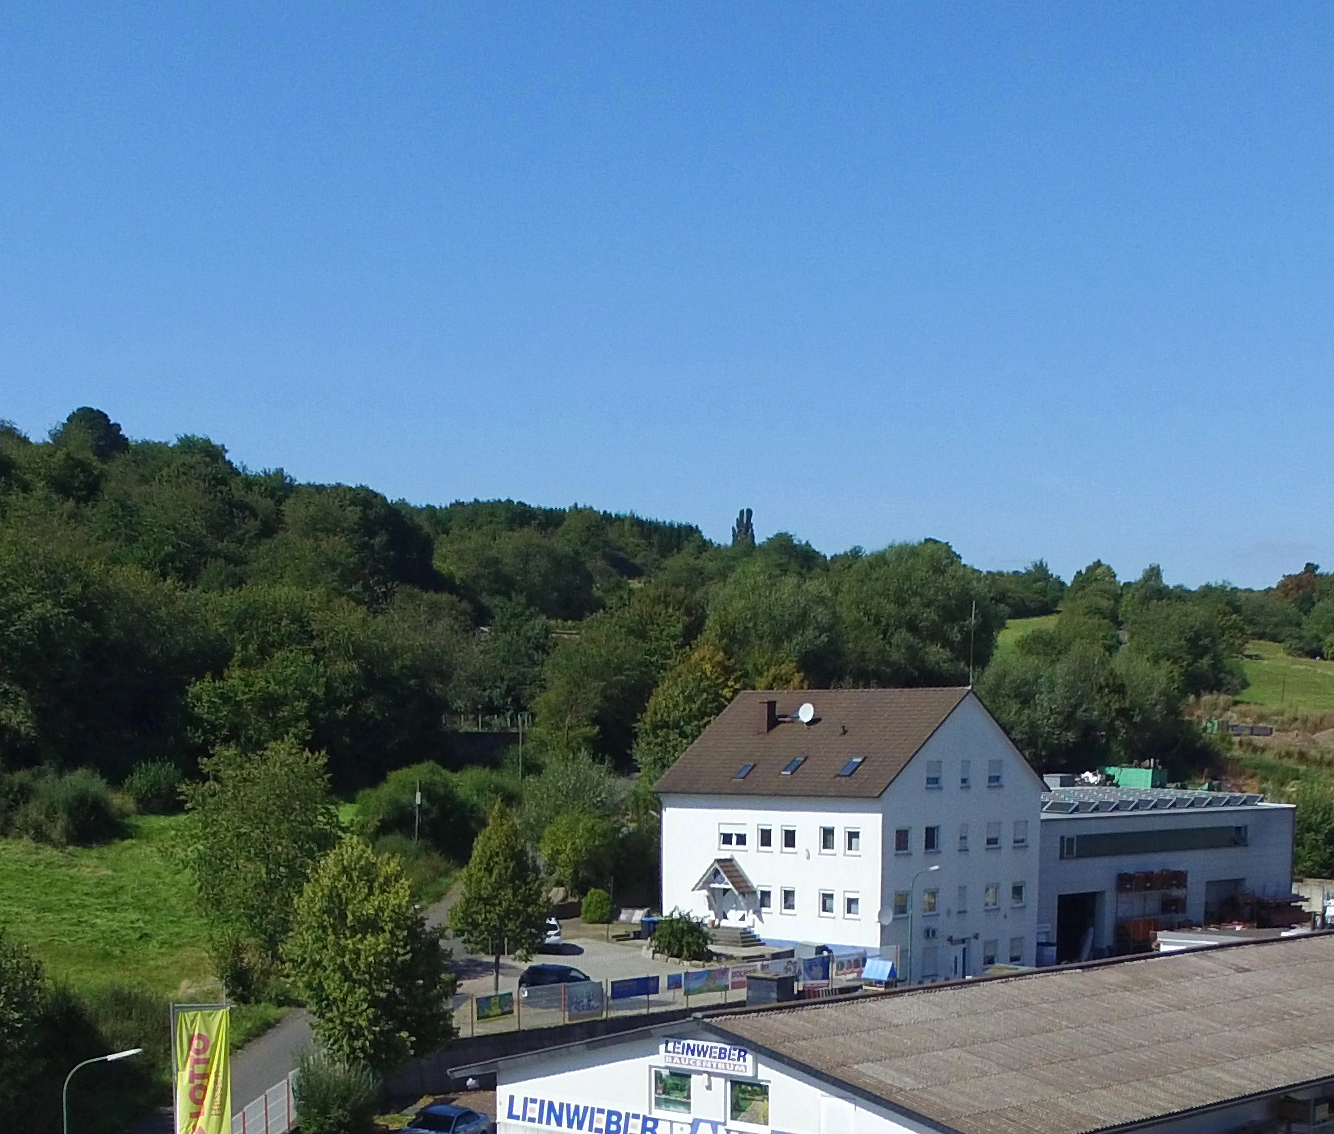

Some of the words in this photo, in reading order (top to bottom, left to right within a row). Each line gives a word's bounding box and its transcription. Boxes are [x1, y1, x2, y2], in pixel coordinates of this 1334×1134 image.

[665, 1039, 747, 1063] LEINWEBER
[188, 1033, 211, 1119] LOTTO
[665, 1056, 747, 1073] BAUCENTRUM
